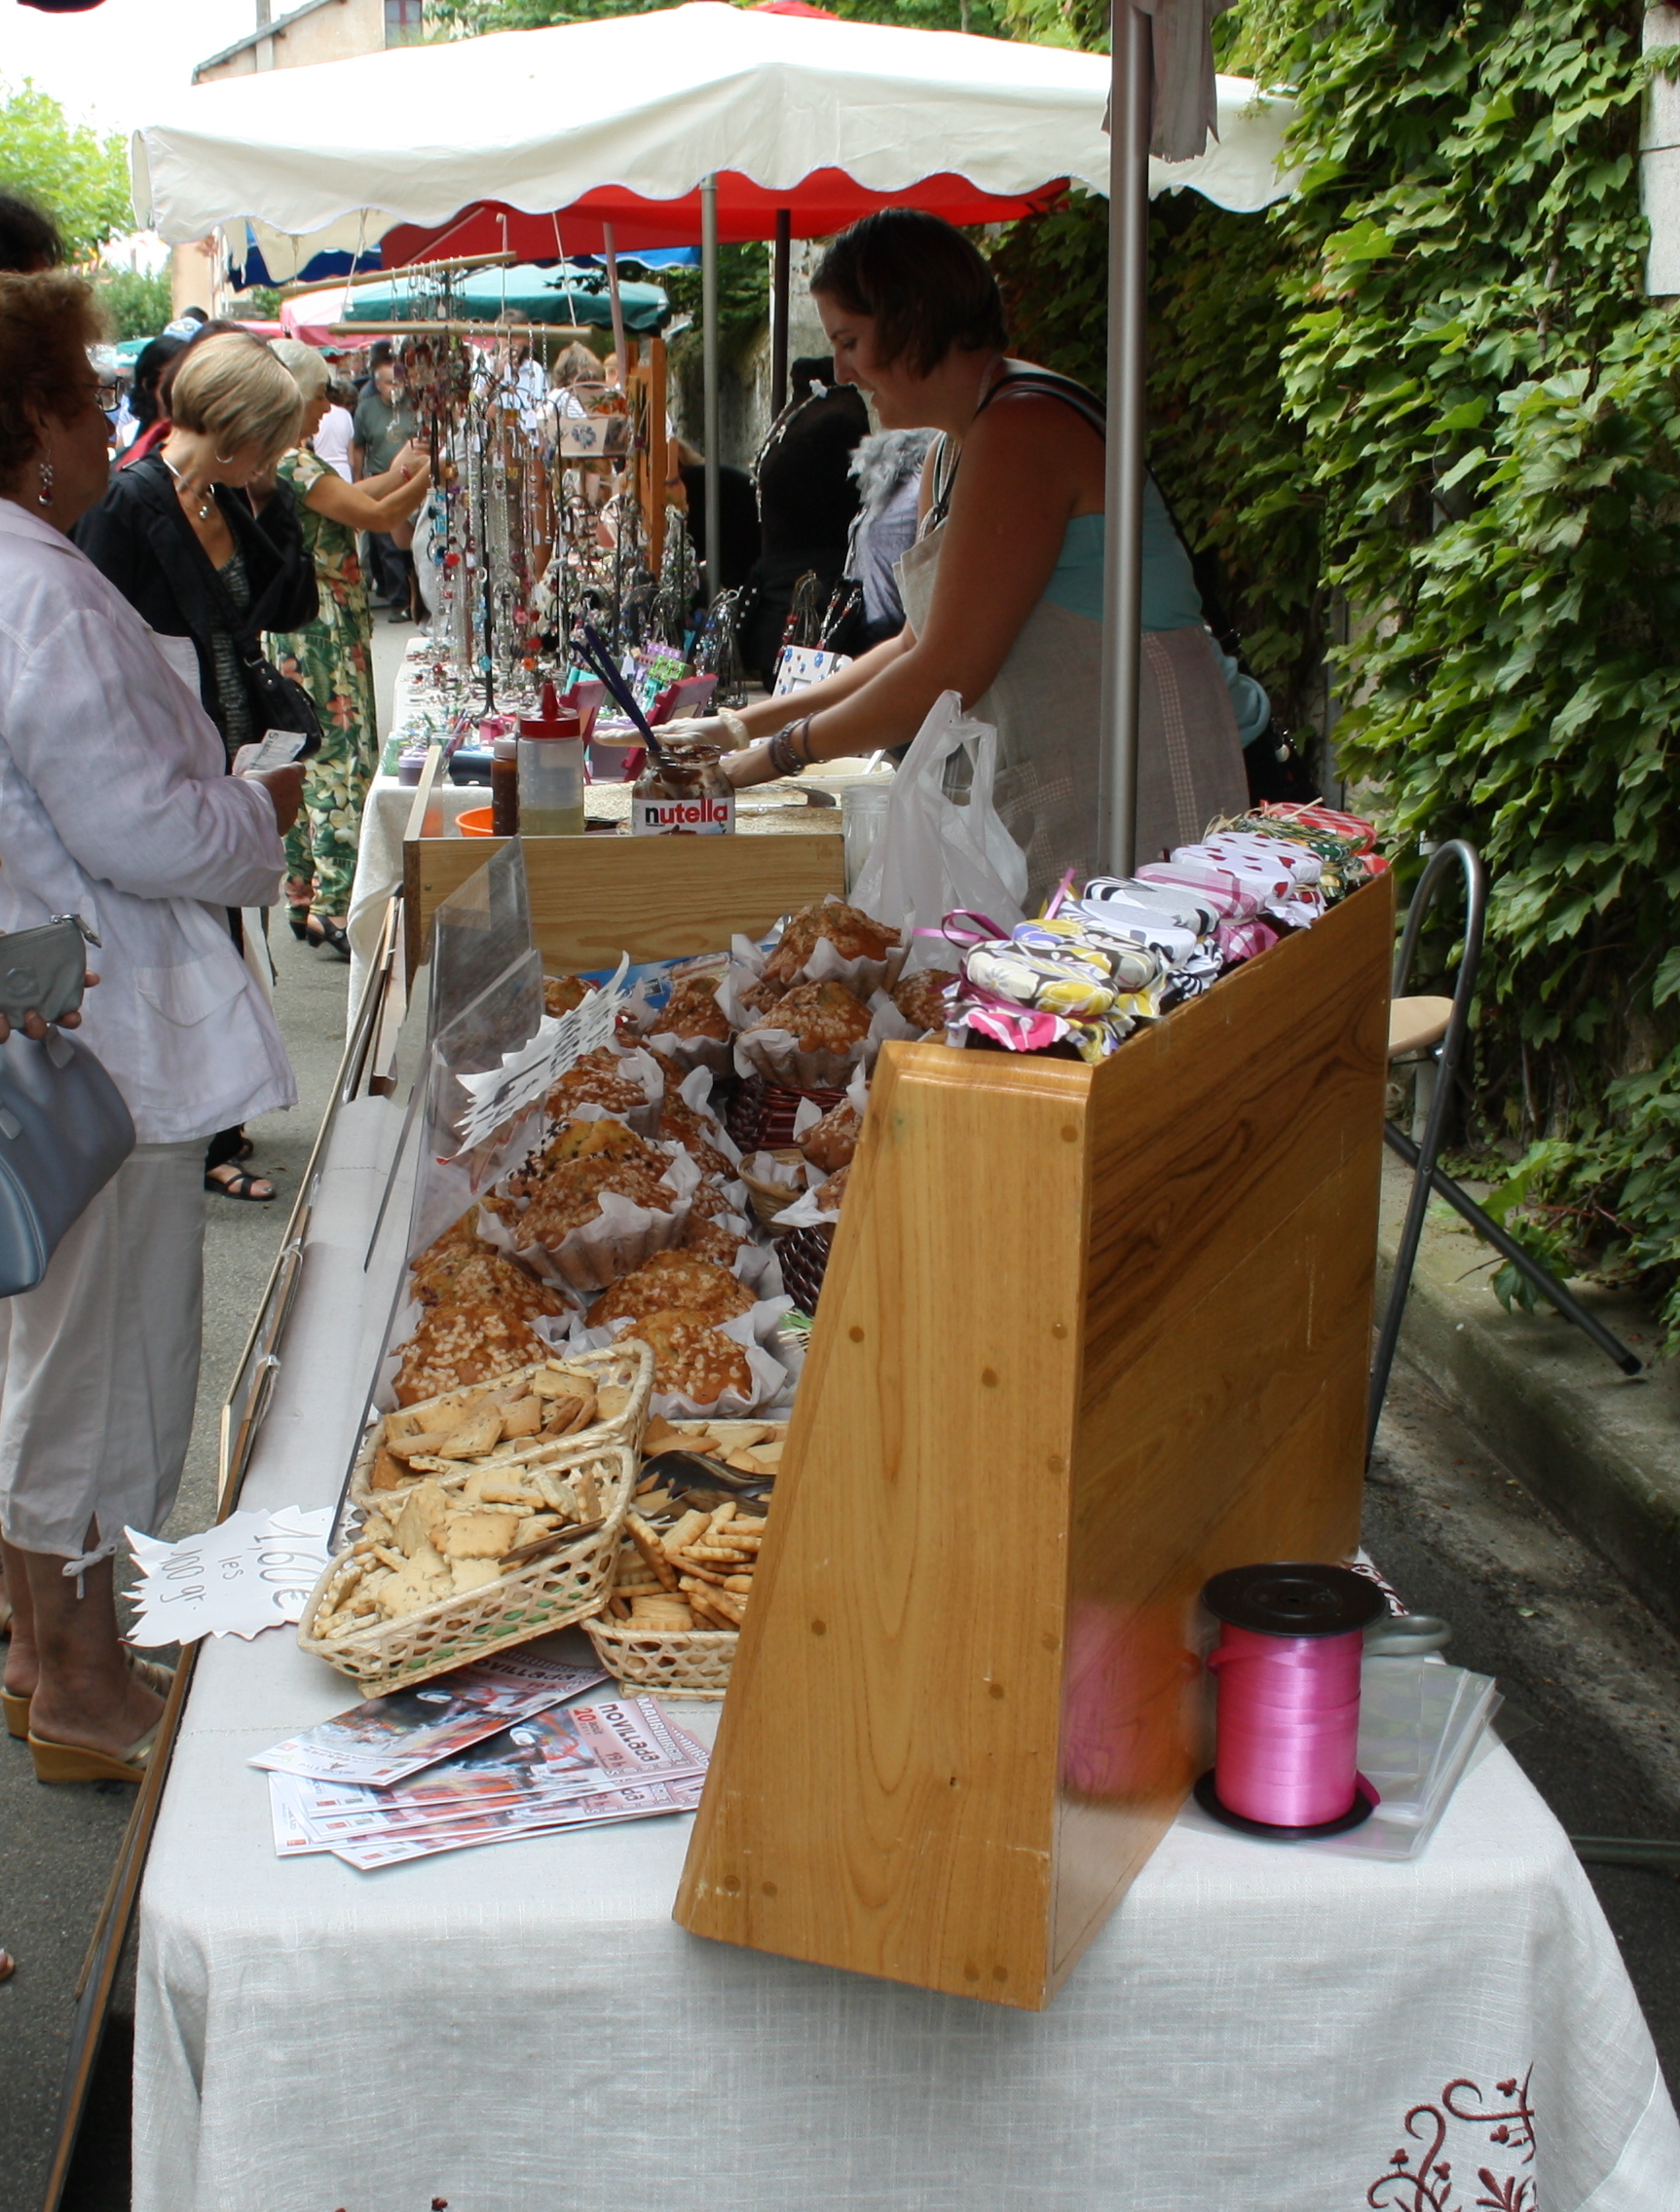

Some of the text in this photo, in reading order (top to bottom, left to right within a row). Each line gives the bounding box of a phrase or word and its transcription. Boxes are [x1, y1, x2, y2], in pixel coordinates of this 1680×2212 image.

[645, 799, 728, 824] nutella
[159, 1549, 205, 1580] 100
[217, 1556, 243, 1580] les
[573, 1707, 597, 1722] 20
